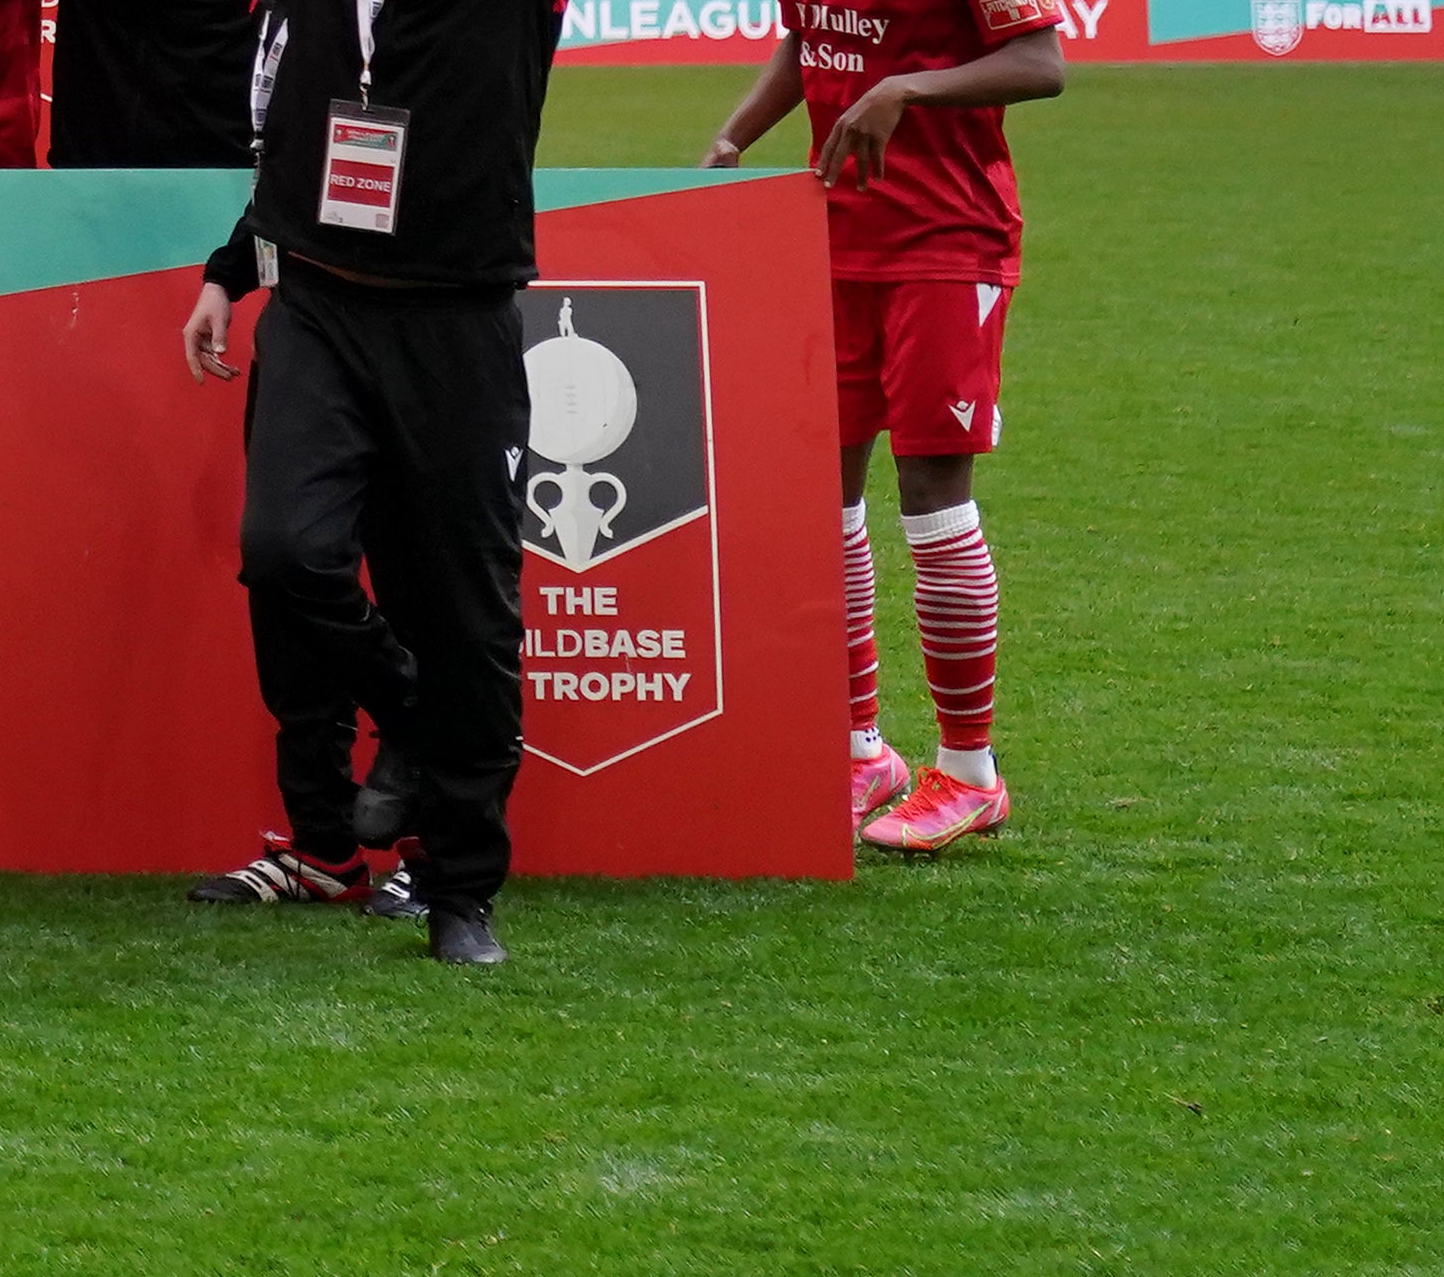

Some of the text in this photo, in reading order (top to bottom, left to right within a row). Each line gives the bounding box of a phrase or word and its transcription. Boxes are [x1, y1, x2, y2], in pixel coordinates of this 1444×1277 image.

[817, 42, 865, 73] Son
[330, 173, 392, 193] RED ZONE
[539, 587, 618, 616] THE
[521, 628, 686, 661] ILDBASE
[528, 672, 691, 703] TROPHY
